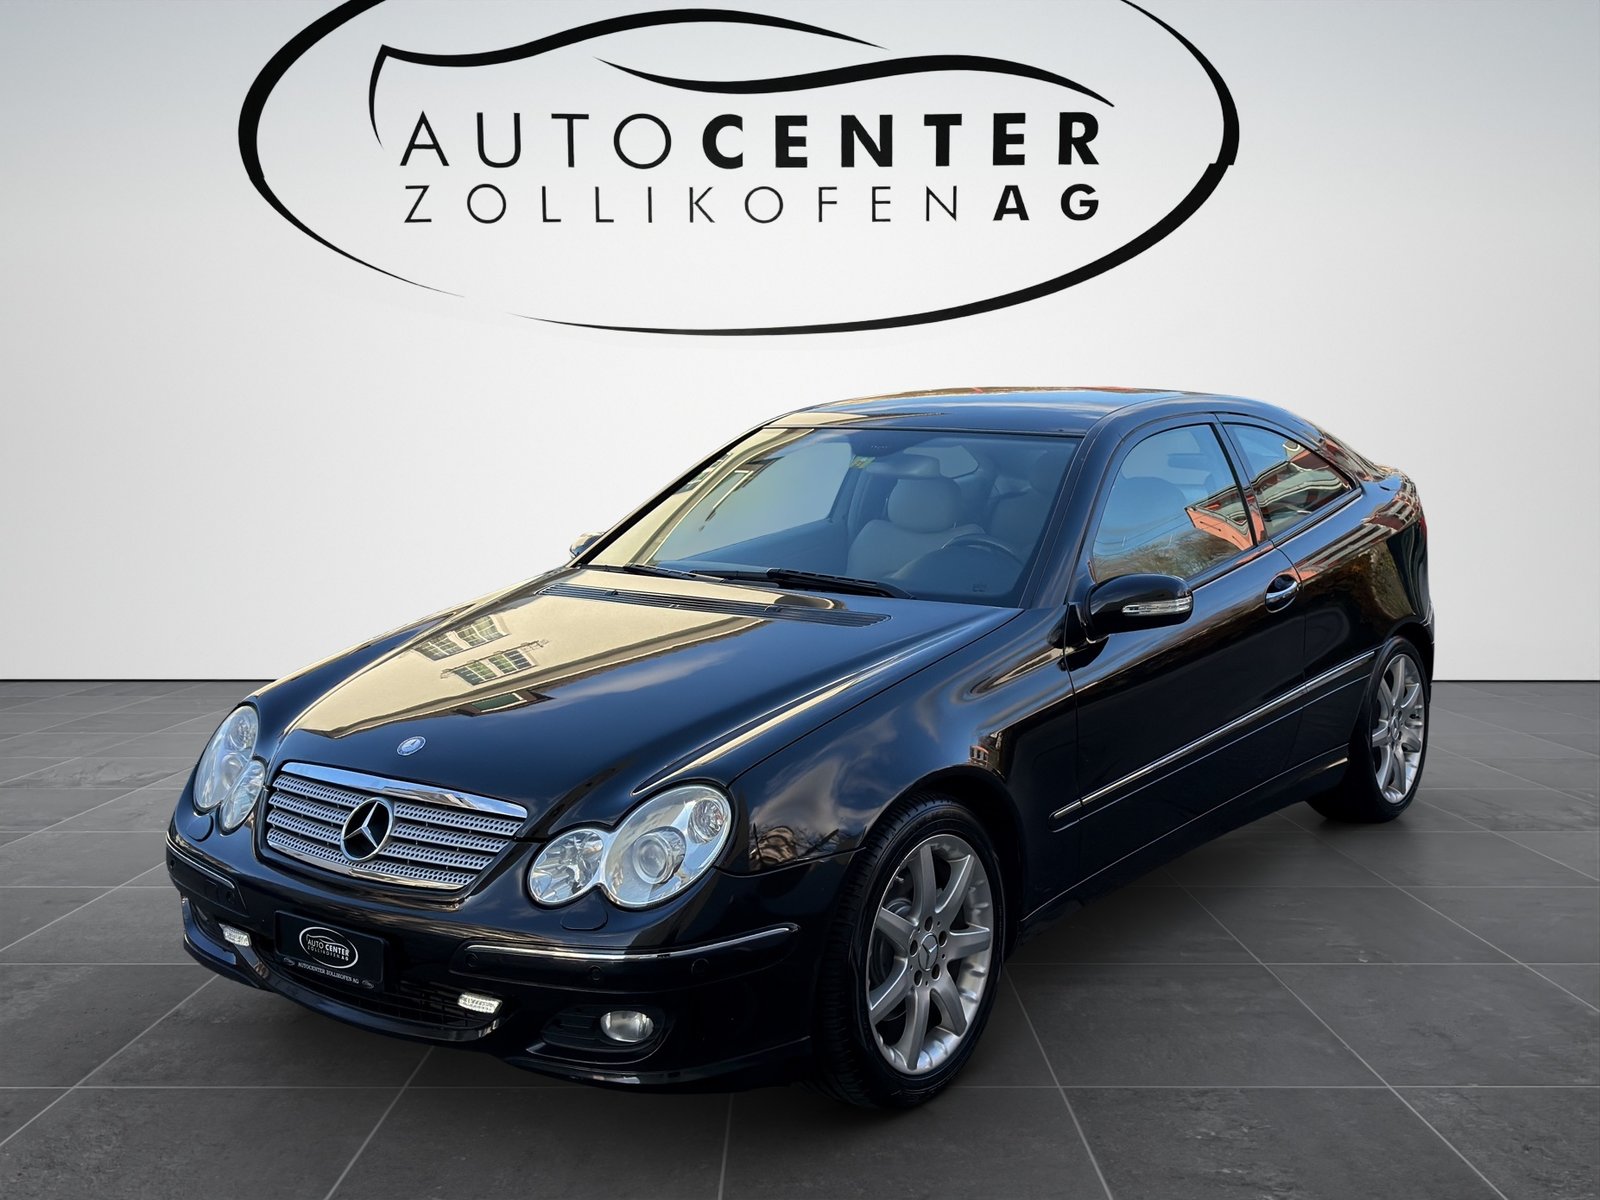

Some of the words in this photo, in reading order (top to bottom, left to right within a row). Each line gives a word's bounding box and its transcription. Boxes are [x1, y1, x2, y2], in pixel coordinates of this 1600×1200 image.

[403, 184, 958, 224] ZOLLIKOFEN
[993, 184, 1099, 221] AG
[297, 962, 326, 975] AUTOCENTER
